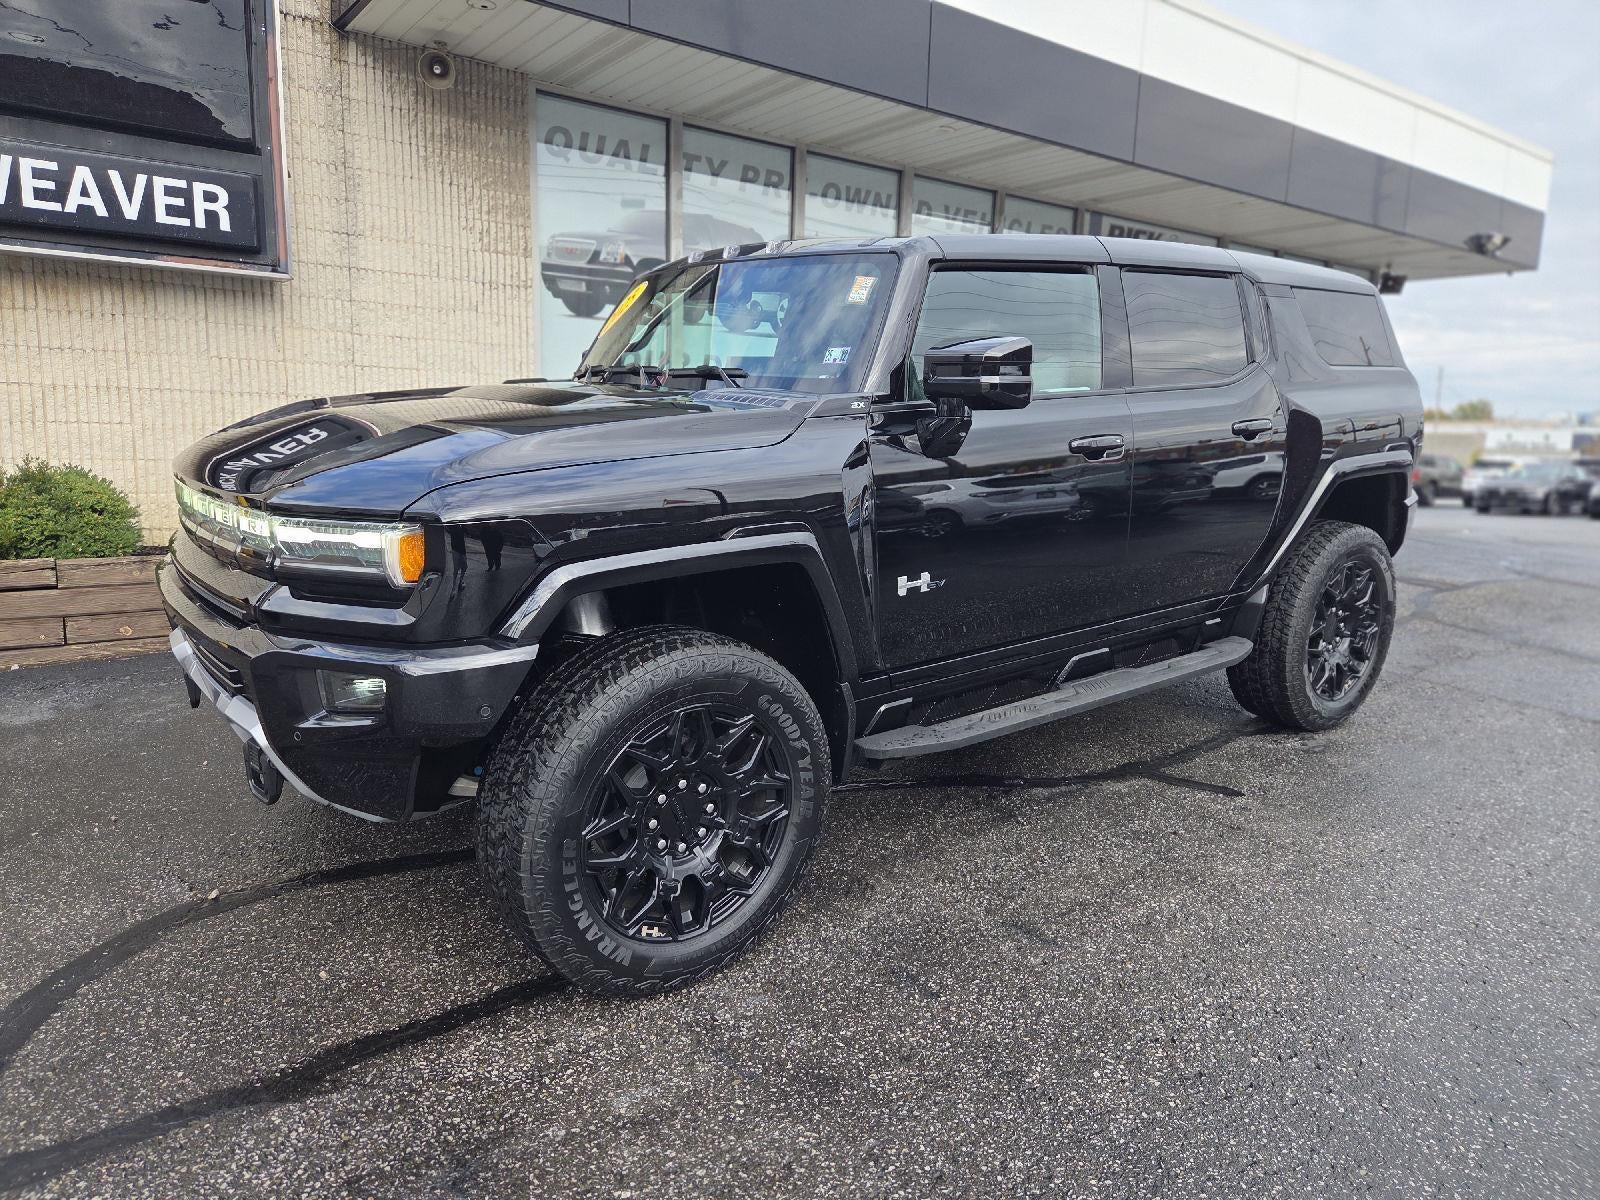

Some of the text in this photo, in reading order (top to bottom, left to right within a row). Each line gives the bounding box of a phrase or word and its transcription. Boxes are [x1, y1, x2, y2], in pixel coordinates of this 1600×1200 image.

[544, 125, 729, 187] QUALTY
[739, 163, 933, 224] PR-OWND
[562, 838, 633, 967] WRANGLER
